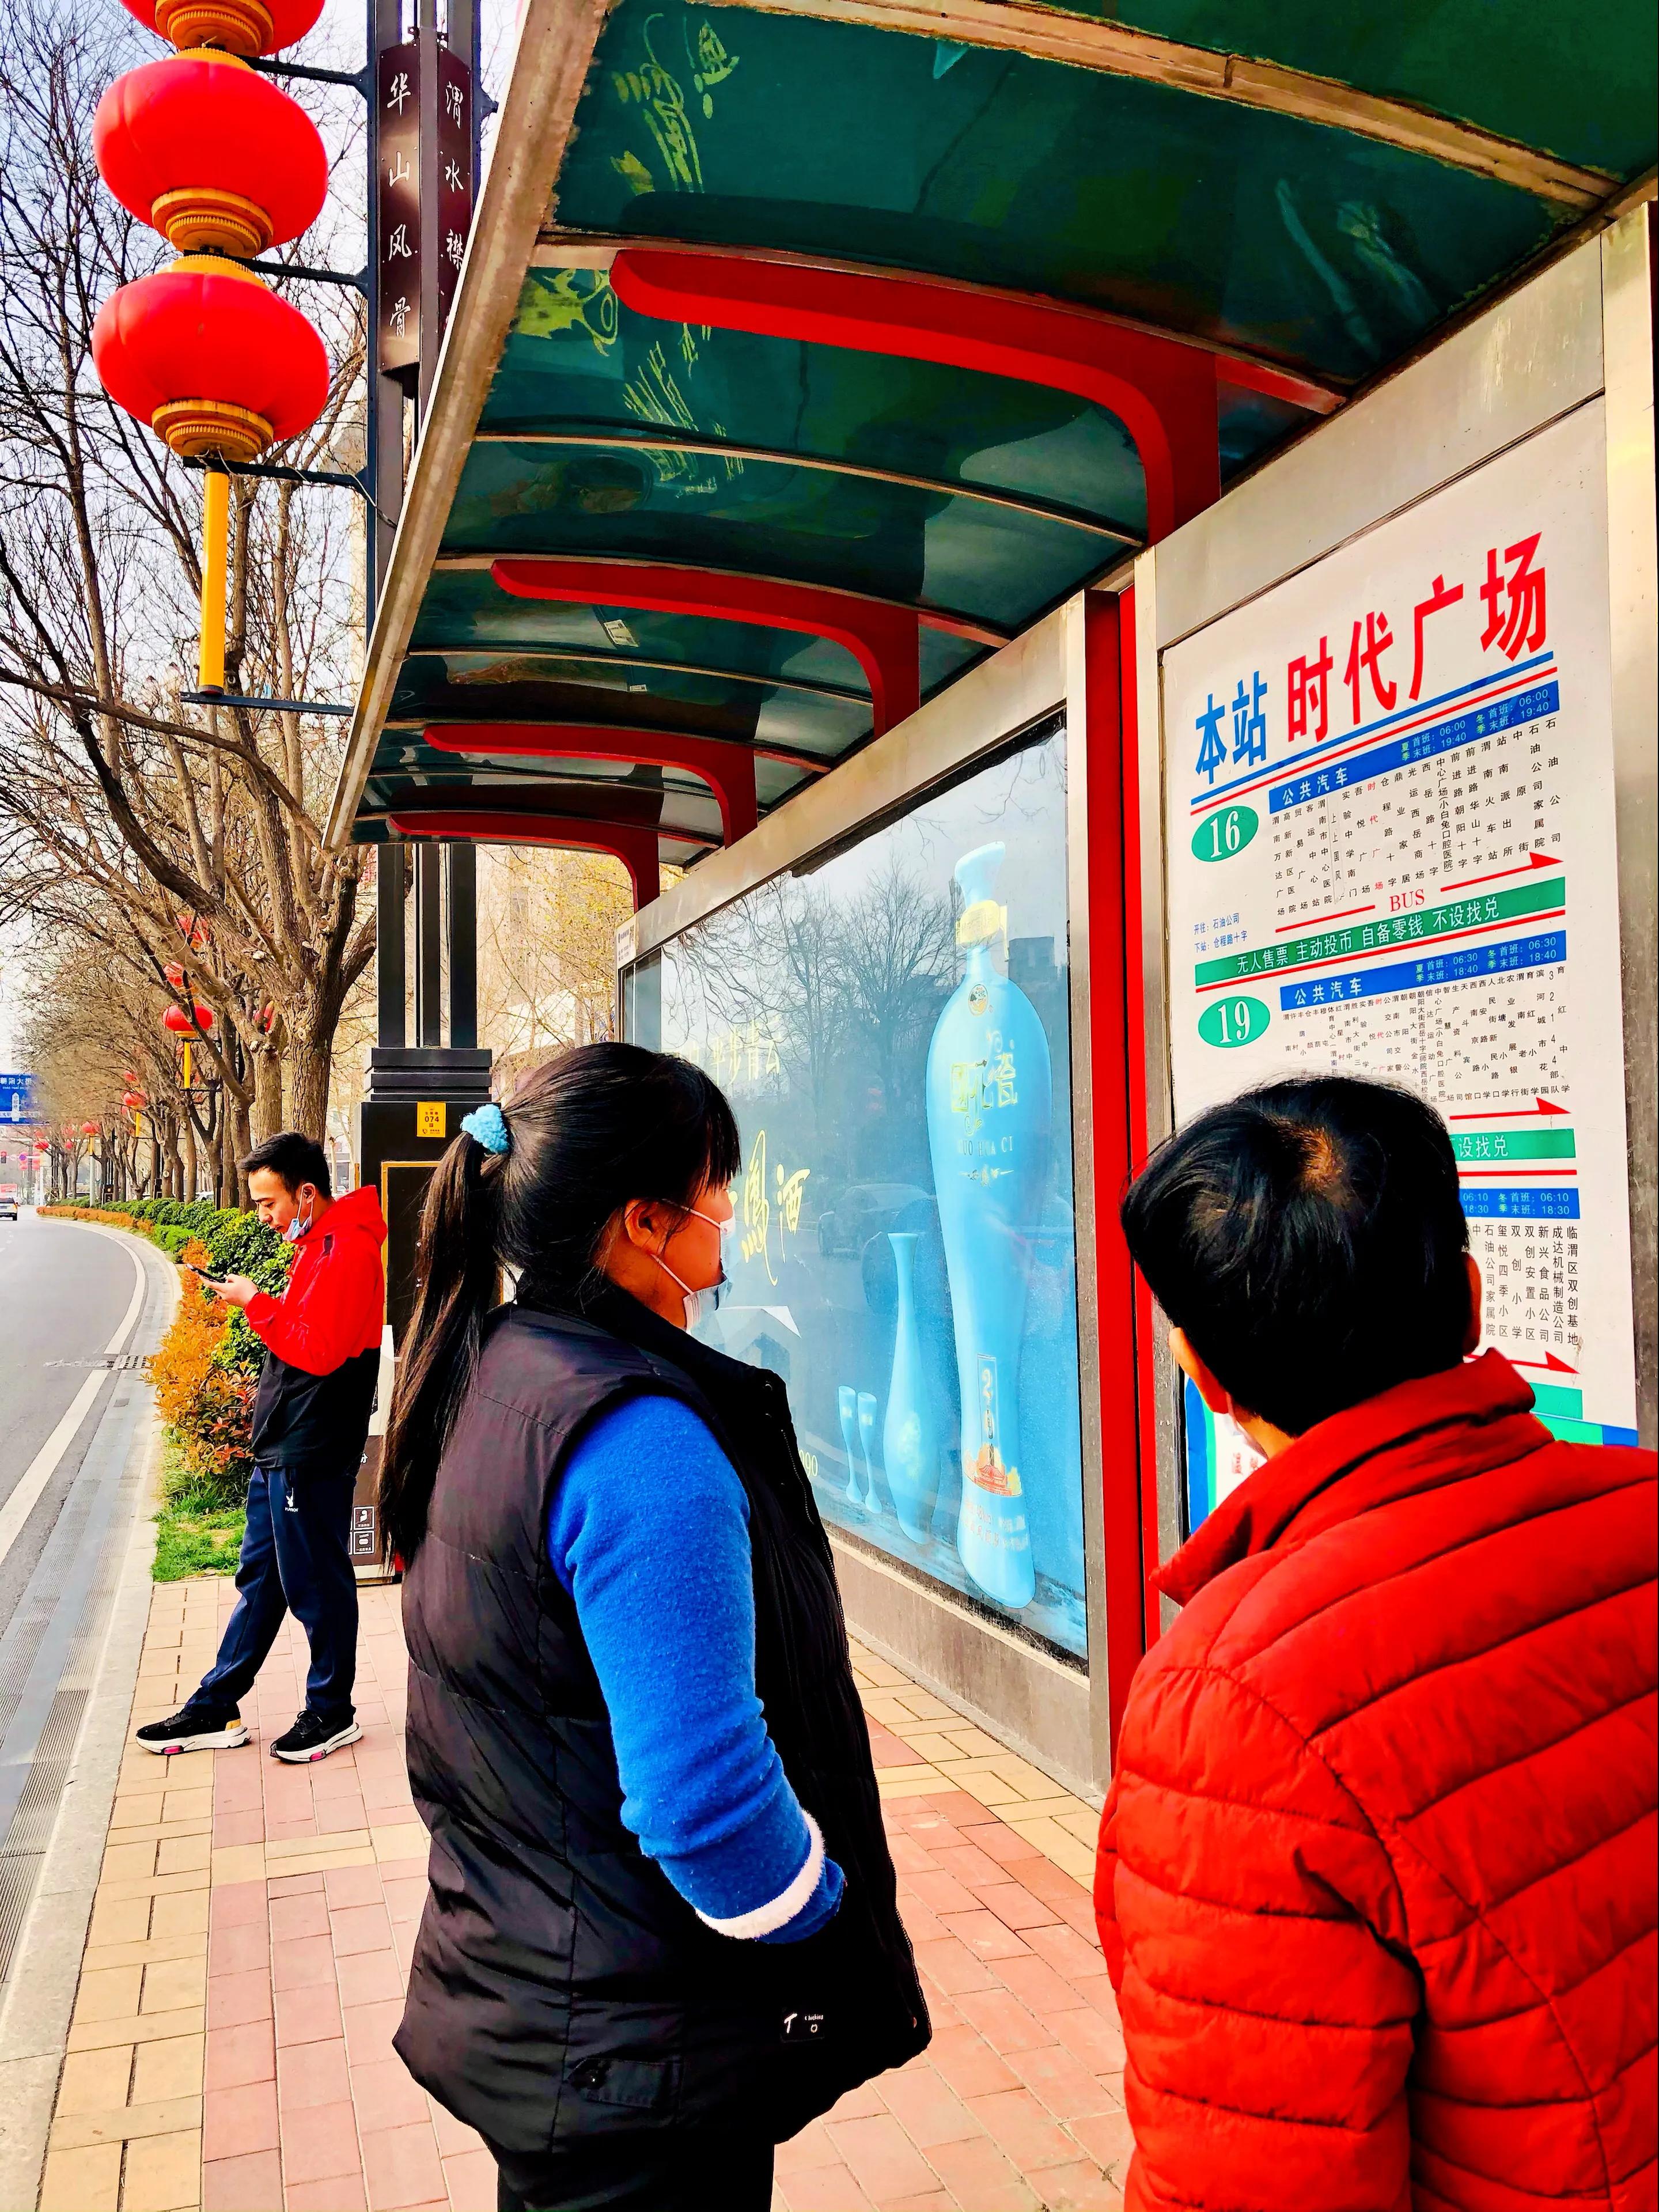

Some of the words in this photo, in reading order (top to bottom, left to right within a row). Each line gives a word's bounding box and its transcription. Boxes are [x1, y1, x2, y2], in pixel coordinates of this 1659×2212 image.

[387, 73, 412, 339] 华山风骨
[445, 81, 465, 271] 渭水襟
[1195, 671, 1268, 784] 本站
[1287, 531, 1548, 743] 时代广场
[1519, 689, 1549, 707] 06:00
[1520, 703, 1550, 721] 19:40
[1401, 741, 1410, 762] 夏季
[1440, 721, 1466, 737] 06:00
[1441, 732, 1467, 748] 19:40
[1476, 714, 1486, 734] 冬季
[1209, 810, 1240, 857] 16
[1282, 767, 1348, 805] 公共汽车
[1380, 777, 1397, 887] 仓程路十字
[1394, 772, 1411, 884] 鼎业家居
[1408, 767, 1425, 880] 光运西岳商场
[1422, 762, 1439, 876] 西岳路十字
[1450, 752, 1468, 868] 前进路朝阳十字
[1465, 747, 1483, 864] 前进路华山十字
[1480, 741, 1498, 860] 渭南火车站
[1496, 736, 1513, 857] 站南派出所
[1513, 730, 1529, 852] 中原街
[1528, 724, 1546, 848] 石油公司家属院
[1546, 717, 1561, 843] 石油公司
[1272, 816, 1285, 916] 渭南万达广场
[1283, 812, 1297, 913] 高新新区医院
[1294, 808, 1308, 910] 贸易广场
[1305, 804, 1320, 907] 客运中心站
[1317, 799, 1332, 904] 渭南市中心医院
[1342, 791, 1358, 897] 实验中学南门
[1354, 786, 1370, 893] 吾悦广场
[1367, 782, 1383, 890] 时代广场
[1213, 912, 1240, 930] 石油公司
[1213, 930, 1248, 948] 仓程路十字
[1237, 946, 1289, 974] 无人售票
[1296, 930, 1351, 962] 主动投币
[1362, 915, 1424, 948] 自备零钱
[1433, 897, 1500, 931] 不设找兑
[1390, 889, 1426, 912] BUS
[1528, 937, 1556, 950] 06:30
[1295, 978, 1362, 1006] 公共汽车
[1416, 964, 1425, 983] 夏季
[1453, 953, 1478, 965] 06:30
[1454, 965, 1478, 976] 18:40
[1487, 949, 1497, 969] 冬季
[1529, 949, 1556, 963] 18:40
[1218, 1001, 1252, 1046] 19
[1426, 989, 1438, 1103] 信达运动广场
[1443, 986, 1455, 1101] 智慧广场
[1452, 984, 1463, 1100] 生产资料公司
[1469, 982, 1482, 1099] 西南京路口
[1478, 980, 1491, 1099] 西安路小学
[1488, 978, 1499, 1098] 人民街新民路口
[1497, 976, 1509, 1097] 北塘小学
[1506, 975, 1518, 1097] 农业发展银行
[1516, 973, 1529, 1096] 渭南老街
[1527, 971, 1539, 1096] 育红小学
[1536, 969, 1550, 1094] 滨河城市花园
[1548, 971, 1560, 1093] 32144部队
[1556, 966, 1570, 1093] 育红中学
[1001, 1135, 1014, 1153] CI
[1450, 1135, 1509, 1158] 设找兑
[1540, 1193, 1569, 1202] 06:10
[1499, 1193, 1508, 1213] 冬季
[1542, 1206, 1570, 1215] 18:30
[1484, 1225, 1495, 1336] 石油公司家属院
[1498, 1225, 1509, 1337] 玺悦四季小区
[1511, 1225, 1522, 1339] 双创小学
[1525, 1225, 1536, 1340] 双创安置小区
[1538, 1226, 1550, 1342] 新兴食品公司
[1552, 1226, 1564, 1344] 成达机械制造公司
[1567, 1226, 1578, 1346] 临渭区双创基地
